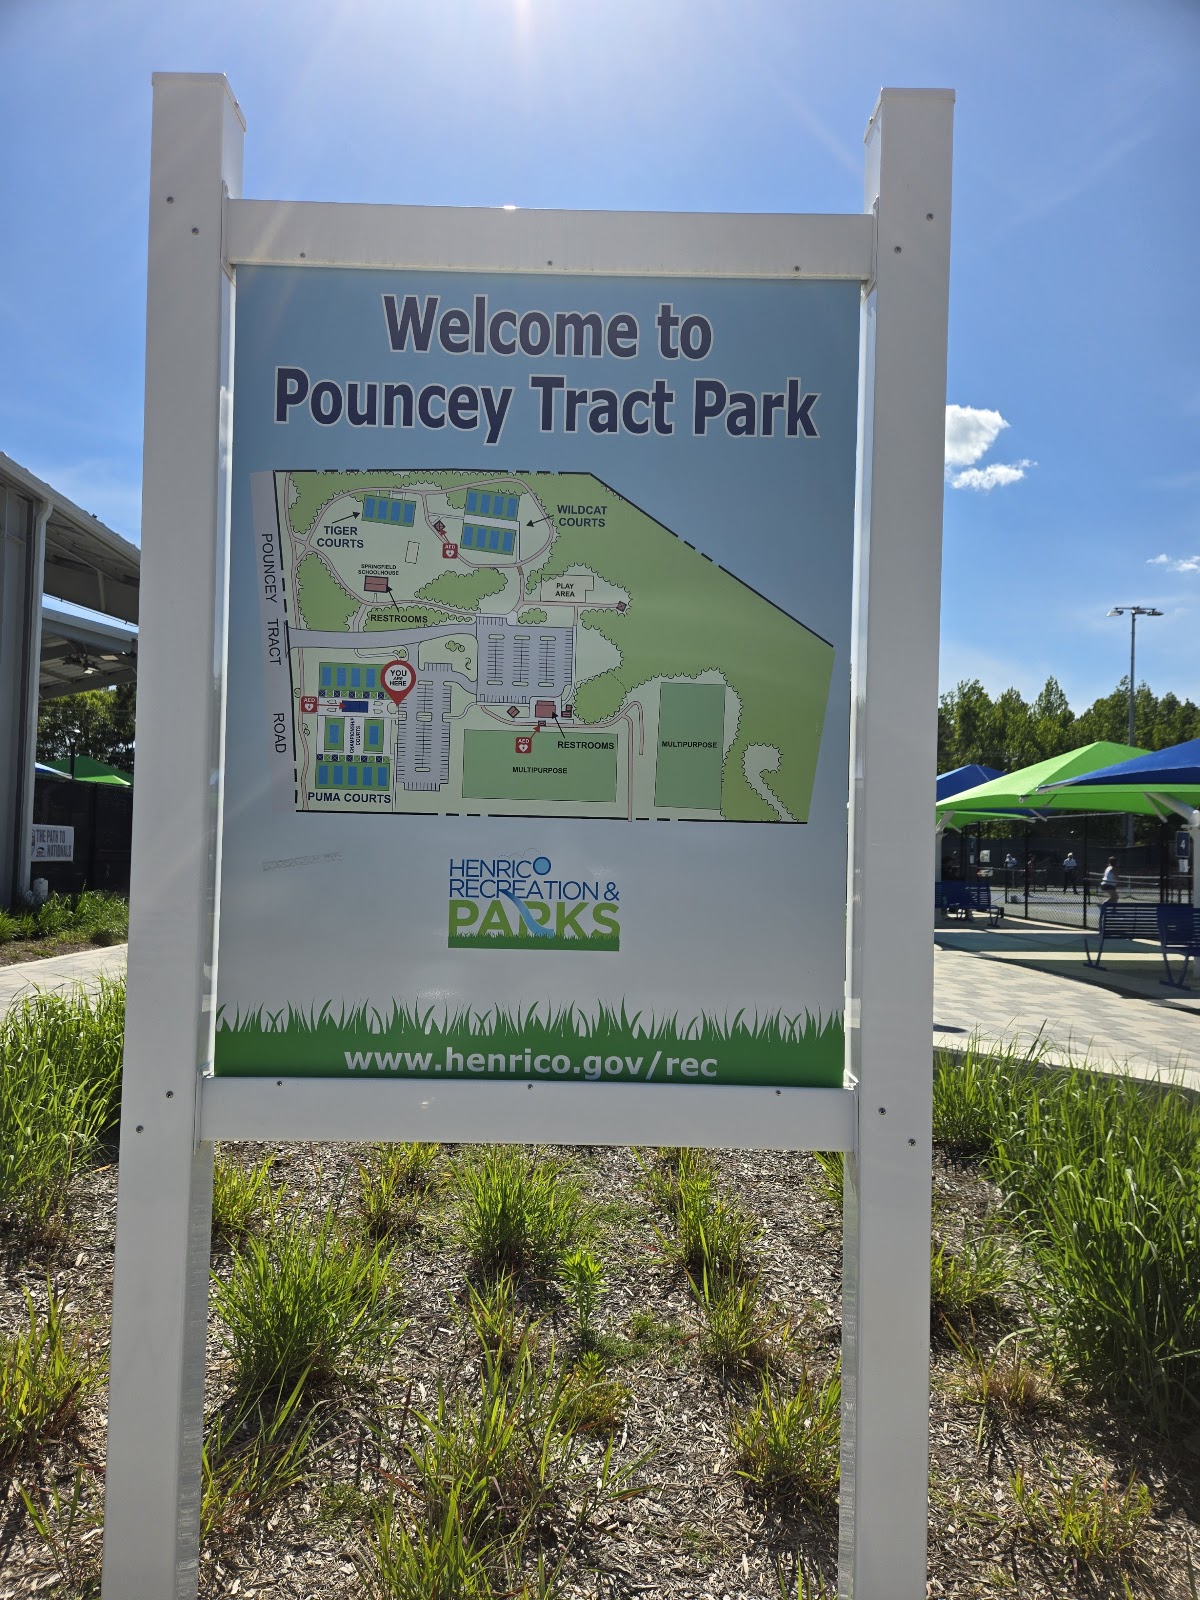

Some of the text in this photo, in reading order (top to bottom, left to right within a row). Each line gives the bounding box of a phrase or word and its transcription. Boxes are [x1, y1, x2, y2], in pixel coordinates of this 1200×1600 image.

[382, 293, 713, 361] Welcome to
[274, 365, 822, 447] Pouncey Tract Park
[556, 504, 608, 516] WILDCAT
[558, 517, 606, 528] COURTS
[323, 525, 358, 536] TIGER
[316, 537, 364, 549] COURTS
[556, 582, 574, 590] PLAY
[555, 590, 576, 598] AREA
[370, 614, 428, 623] RESTROOMS
[261, 532, 287, 754] POUNCEY TRACT ROAD
[389, 669, 407, 677] YOU
[557, 740, 615, 750] RESTROOMS
[661, 740, 718, 749] MULTIPURPOSE
[512, 766, 568, 775] MULTIPURPOSE
[307, 791, 392, 804] PUMA COURTS
[35, 829, 66, 843] THE PATH TO
[1180, 839, 1186, 850] 4
[47, 844, 72, 858] NATIONALS
[449, 856, 552, 879] HENRICO
[449, 878, 621, 901] RECREATION &
[448, 899, 621, 938] PARKS
[344, 1046, 719, 1081] www.henrico.gov/rec
